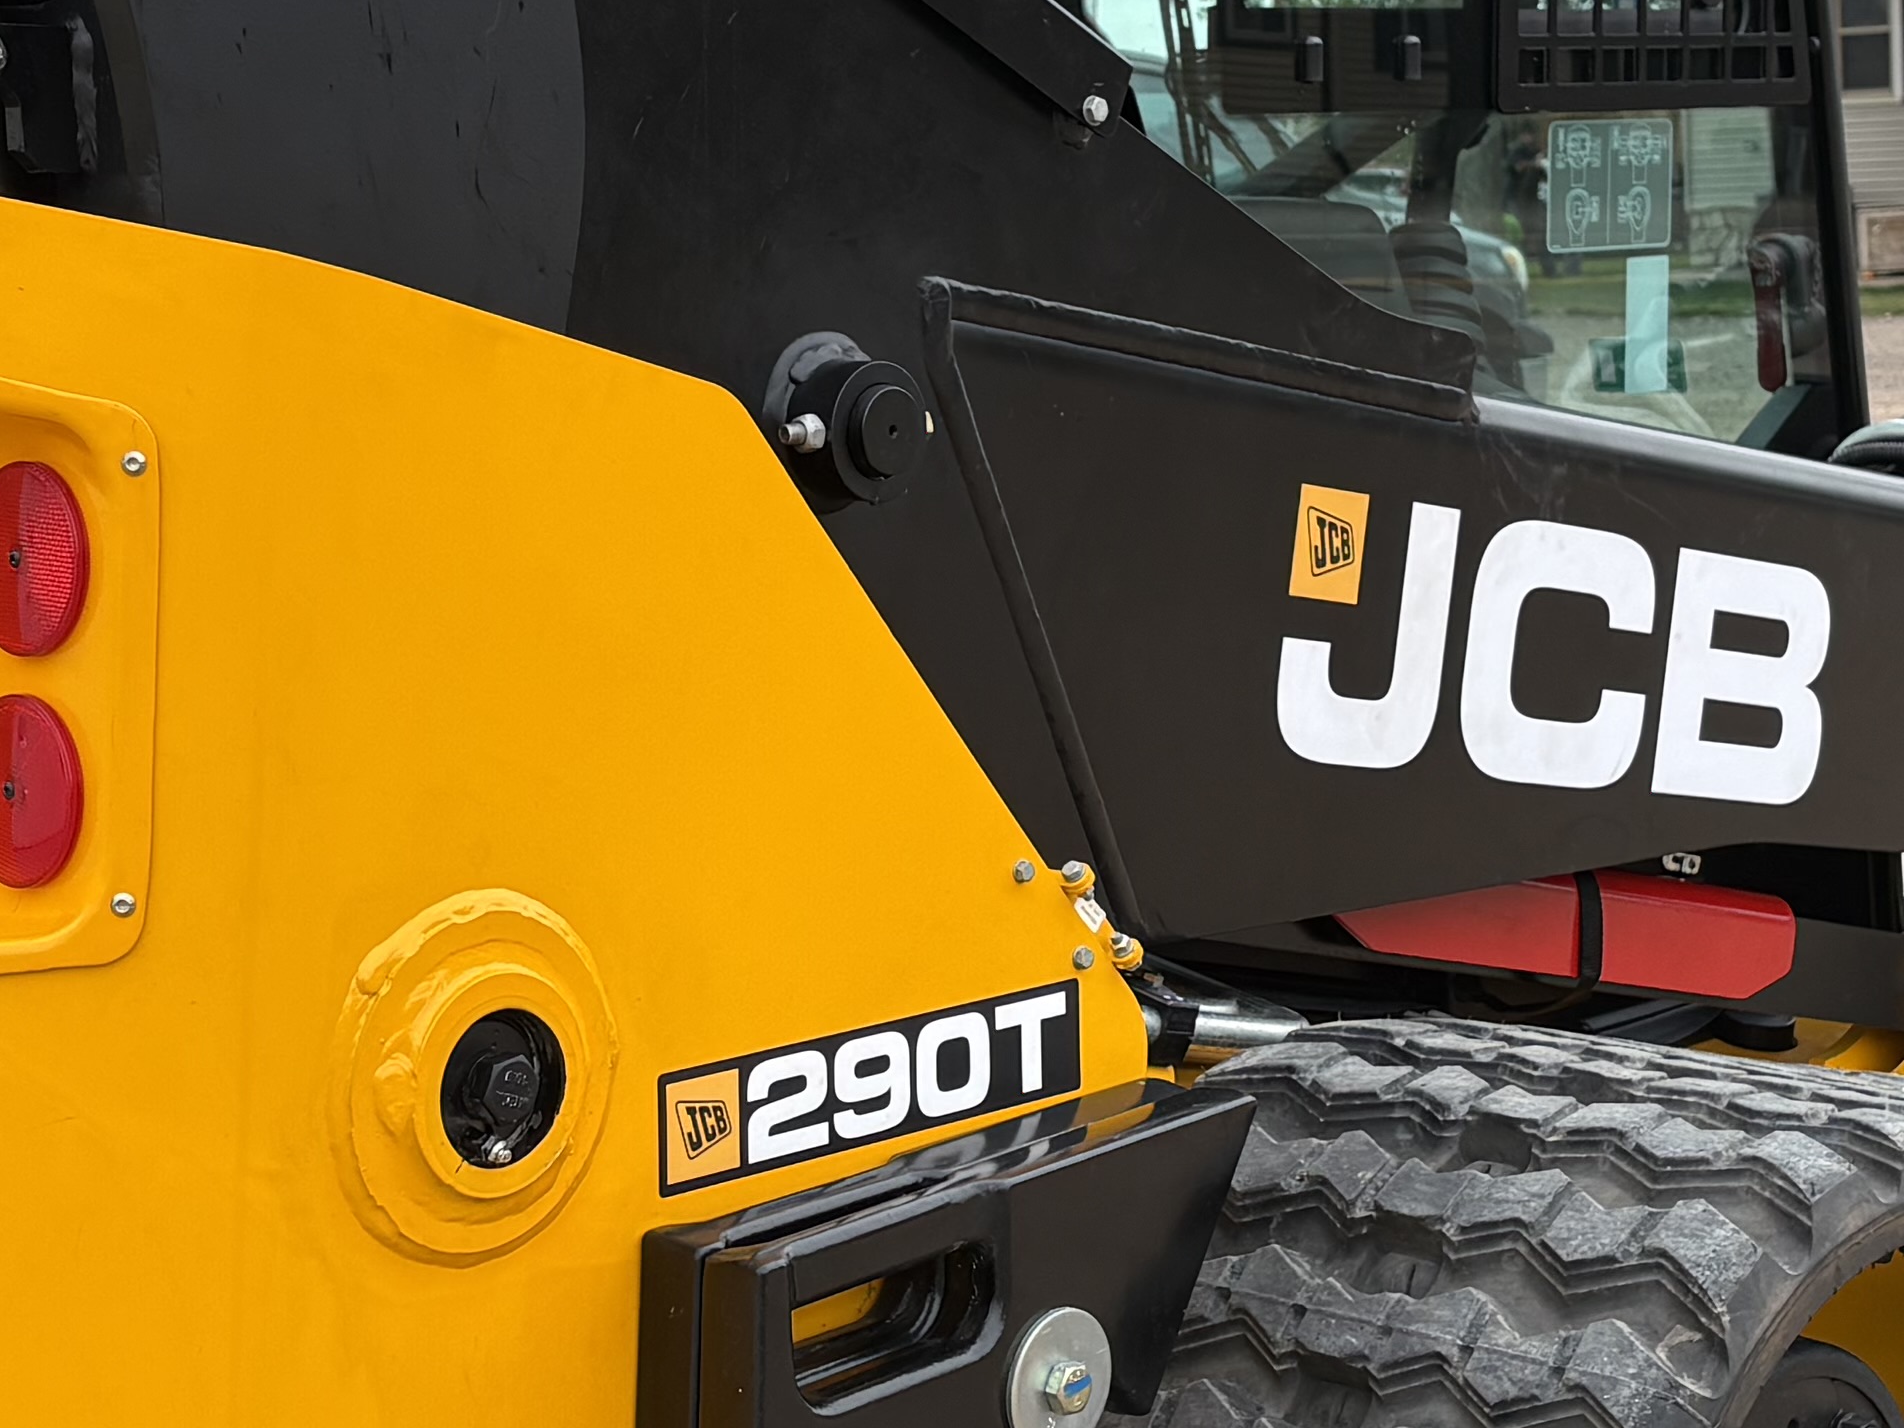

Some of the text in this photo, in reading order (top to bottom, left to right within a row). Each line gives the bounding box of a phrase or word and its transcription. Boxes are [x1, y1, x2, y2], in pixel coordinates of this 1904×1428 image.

[1314, 515, 1351, 569] JCB
[1277, 501, 1831, 806] JCB
[685, 1105, 728, 1152] JCB
[746, 990, 1067, 1165] 290T
